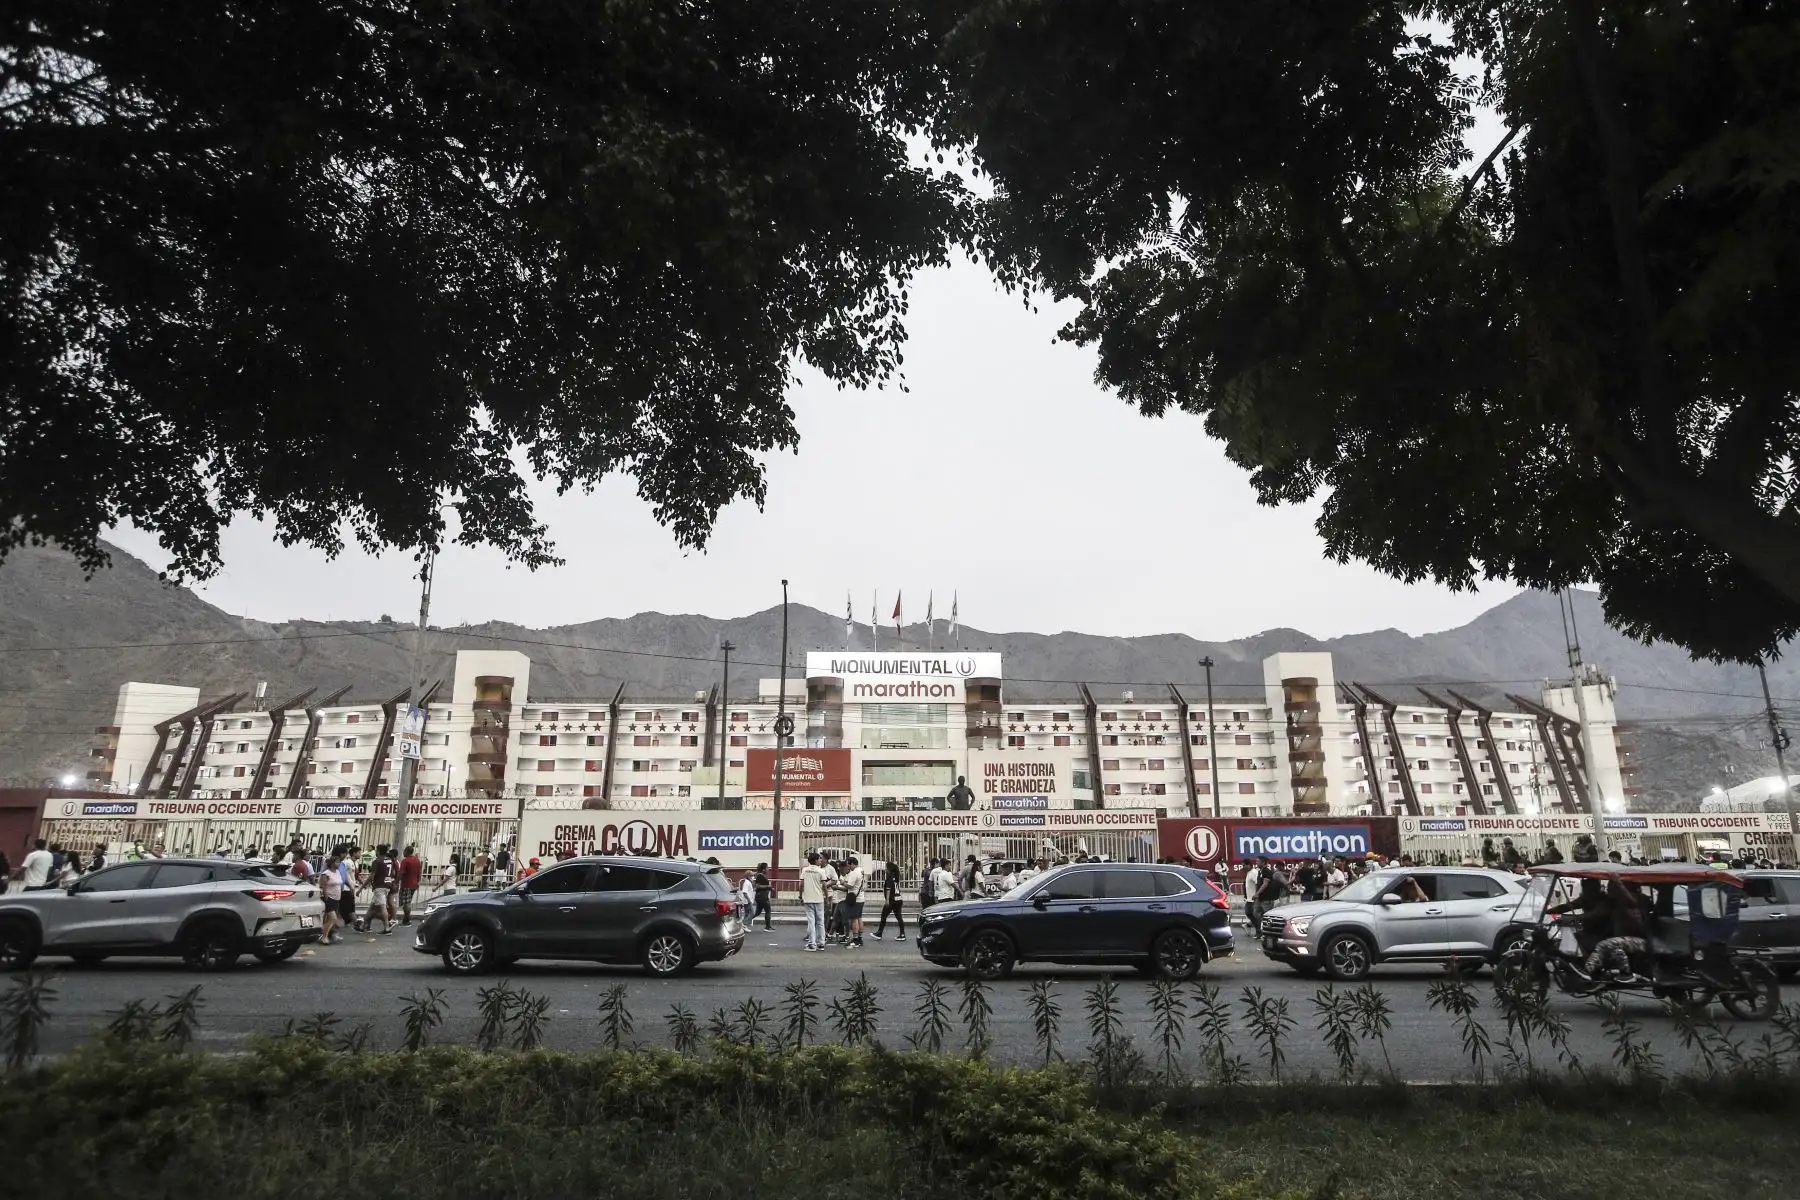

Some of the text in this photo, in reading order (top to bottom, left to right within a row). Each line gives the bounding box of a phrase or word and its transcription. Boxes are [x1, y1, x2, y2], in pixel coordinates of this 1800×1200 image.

[831, 659, 953, 674] MONUMENTAL
[853, 681, 955, 697] marathon
[984, 763, 1055, 777] UNA HISTORIA
[984, 779, 1056, 793] DE GRANDEZA
[83, 803, 136, 814] marathon
[149, 803, 205, 814] TRIBUNA
[208, 803, 282, 814] OCCIDENTE
[316, 803, 365, 814] marathon
[431, 803, 502, 814] OCCIDENTE
[994, 797, 1046, 807] marathon
[820, 817, 864, 826] marathon
[868, 815, 916, 826] TRIBUNA
[917, 815, 978, 826] OCCIDENTE
[1001, 816, 1044, 825] marathon
[1048, 815, 1094, 825] TRIBUNA
[1096, 814, 1156, 824] OCCIDENTE
[1421, 820, 1464, 830] marathon
[1468, 819, 1514, 829] TRIBUNA
[1516, 818, 1580, 828] OCCIDENTE
[1604, 818, 1646, 827] marathon
[1652, 818, 1699, 828] TRIBUNA
[1701, 817, 1760, 827] OCCIDENTE
[555, 825, 596, 840] CREMA
[601, 821, 690, 857] CUNA
[1239, 831, 1366, 854] marathon
